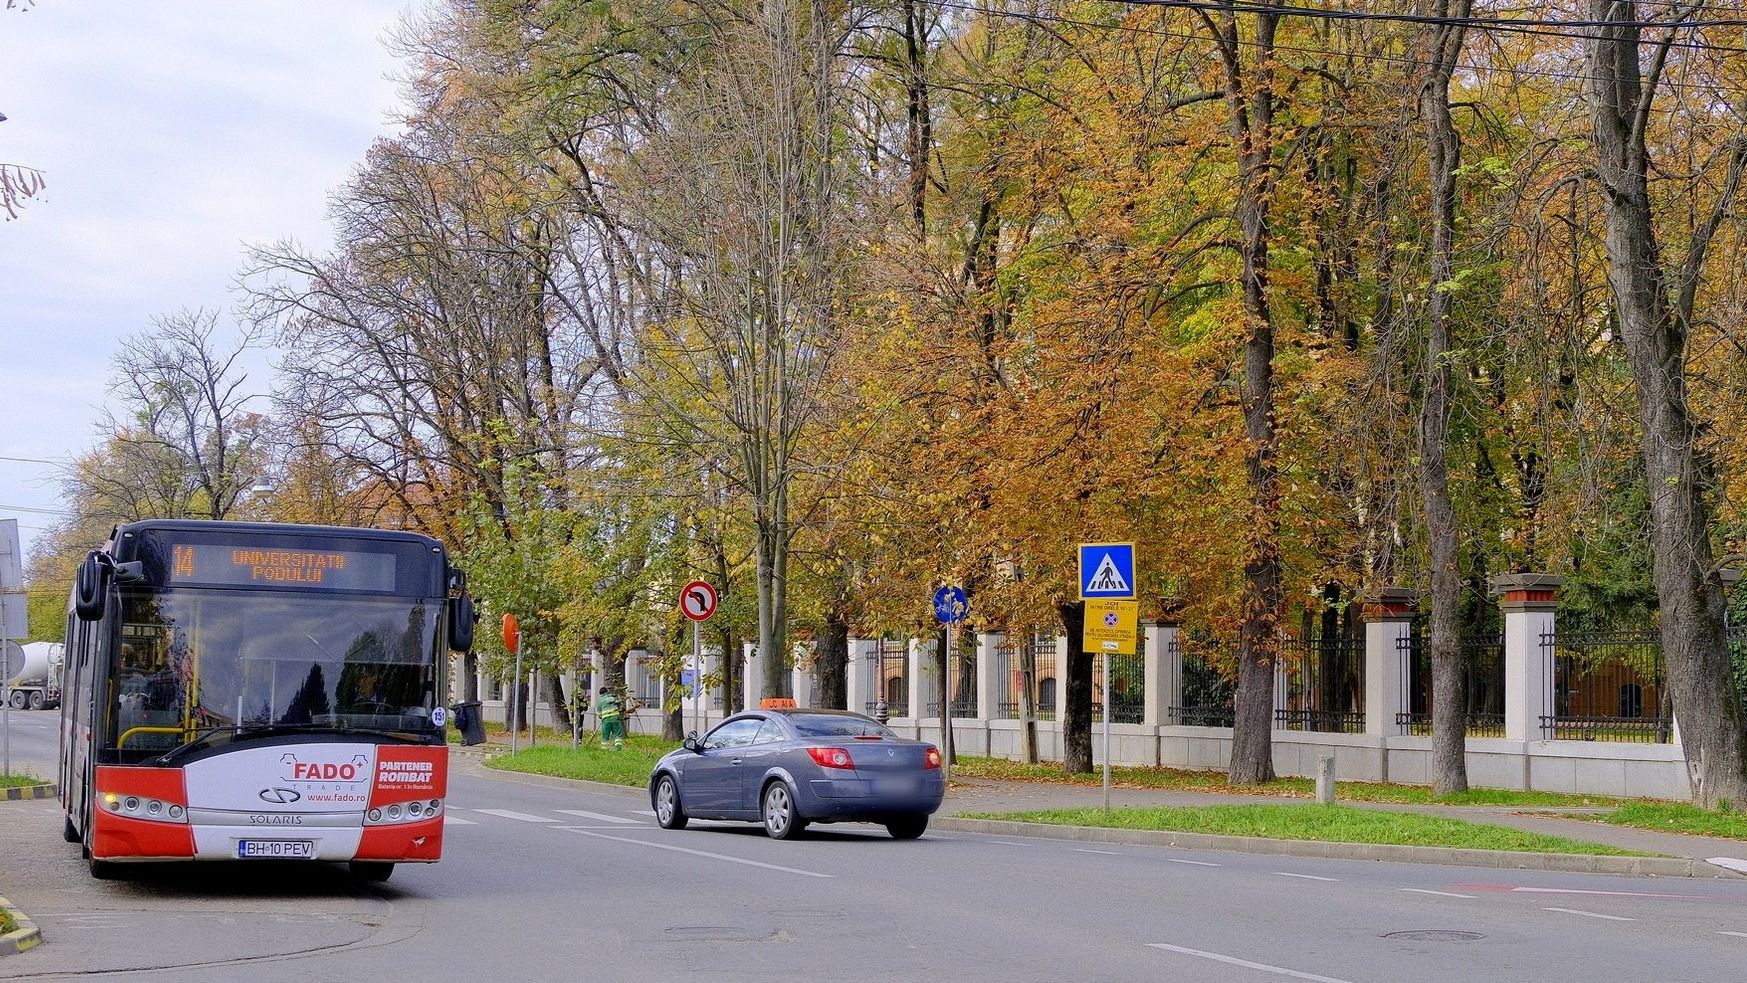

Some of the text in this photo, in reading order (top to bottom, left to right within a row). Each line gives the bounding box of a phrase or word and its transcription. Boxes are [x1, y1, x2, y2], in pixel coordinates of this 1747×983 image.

[175, 545, 345, 576] 14 UNIVERSITATII
[252, 566, 322, 582] PODULUI
[434, 711, 445, 721] 151
[380, 761, 433, 771] PARTENER
[294, 763, 356, 780] FADO
[379, 771, 433, 782] ROMBAT
[293, 784, 356, 792] TRADE
[307, 793, 366, 802] www.fado.ro
[249, 815, 302, 824] SOLARIS
[247, 842, 311, 855] BH 10 PEV
